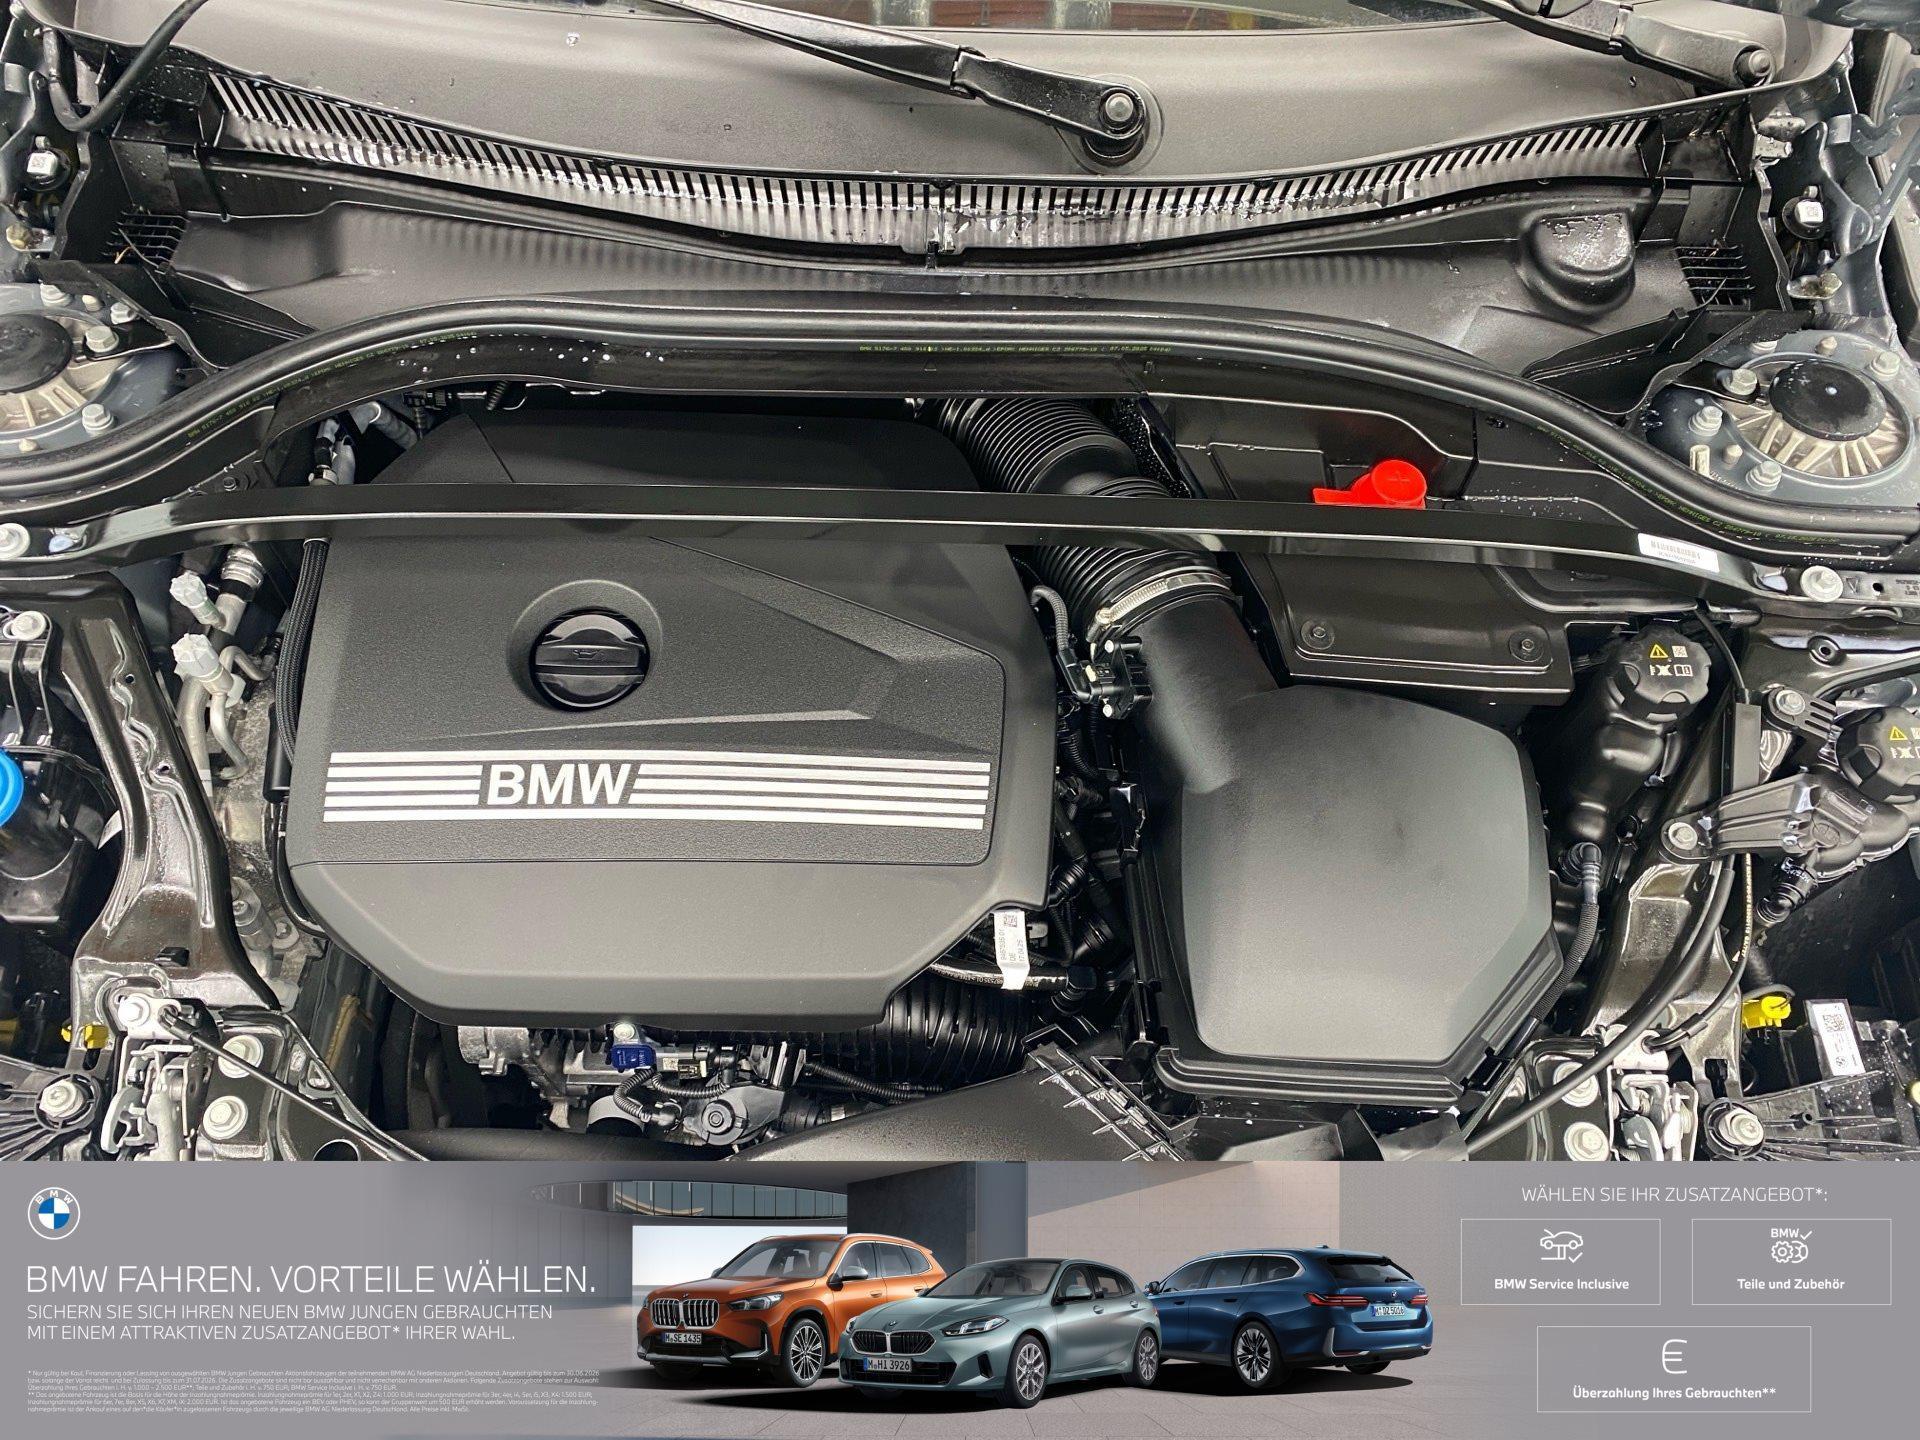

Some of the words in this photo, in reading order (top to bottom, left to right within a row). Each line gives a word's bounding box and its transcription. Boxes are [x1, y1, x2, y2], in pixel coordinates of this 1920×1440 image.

[485, 763, 632, 806] BMW
[683, 1333, 701, 1343] 1435
[889, 1360, 910, 1371] 3926
